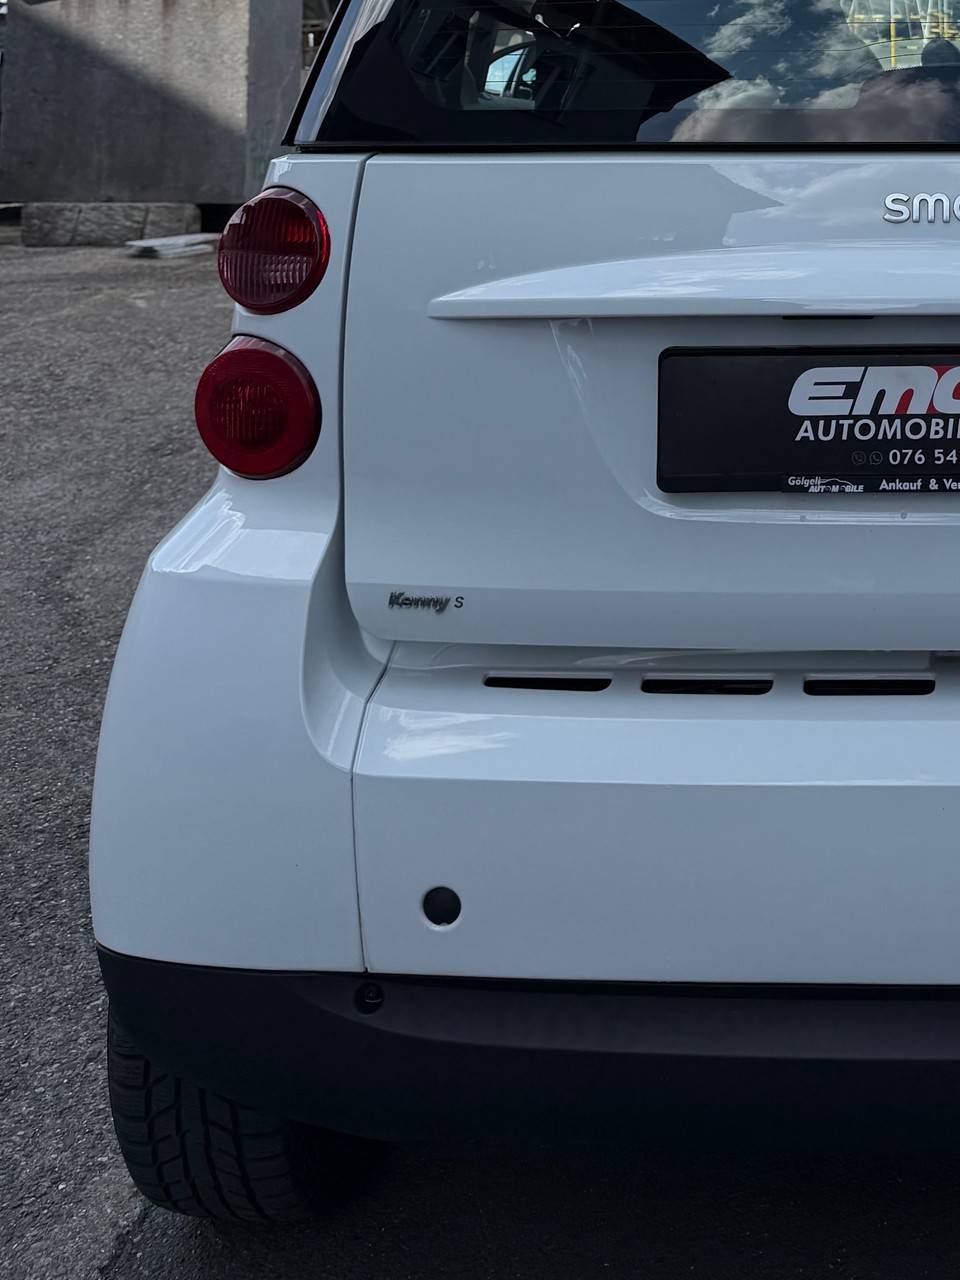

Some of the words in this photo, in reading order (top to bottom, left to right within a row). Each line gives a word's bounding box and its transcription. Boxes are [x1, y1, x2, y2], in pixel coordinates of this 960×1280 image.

[888, 449, 926, 465] 076
[879, 478, 922, 491] Ankauf
[929, 478, 939, 490] &
[388, 591, 451, 615] Kenny
[454, 596, 465, 608] S
